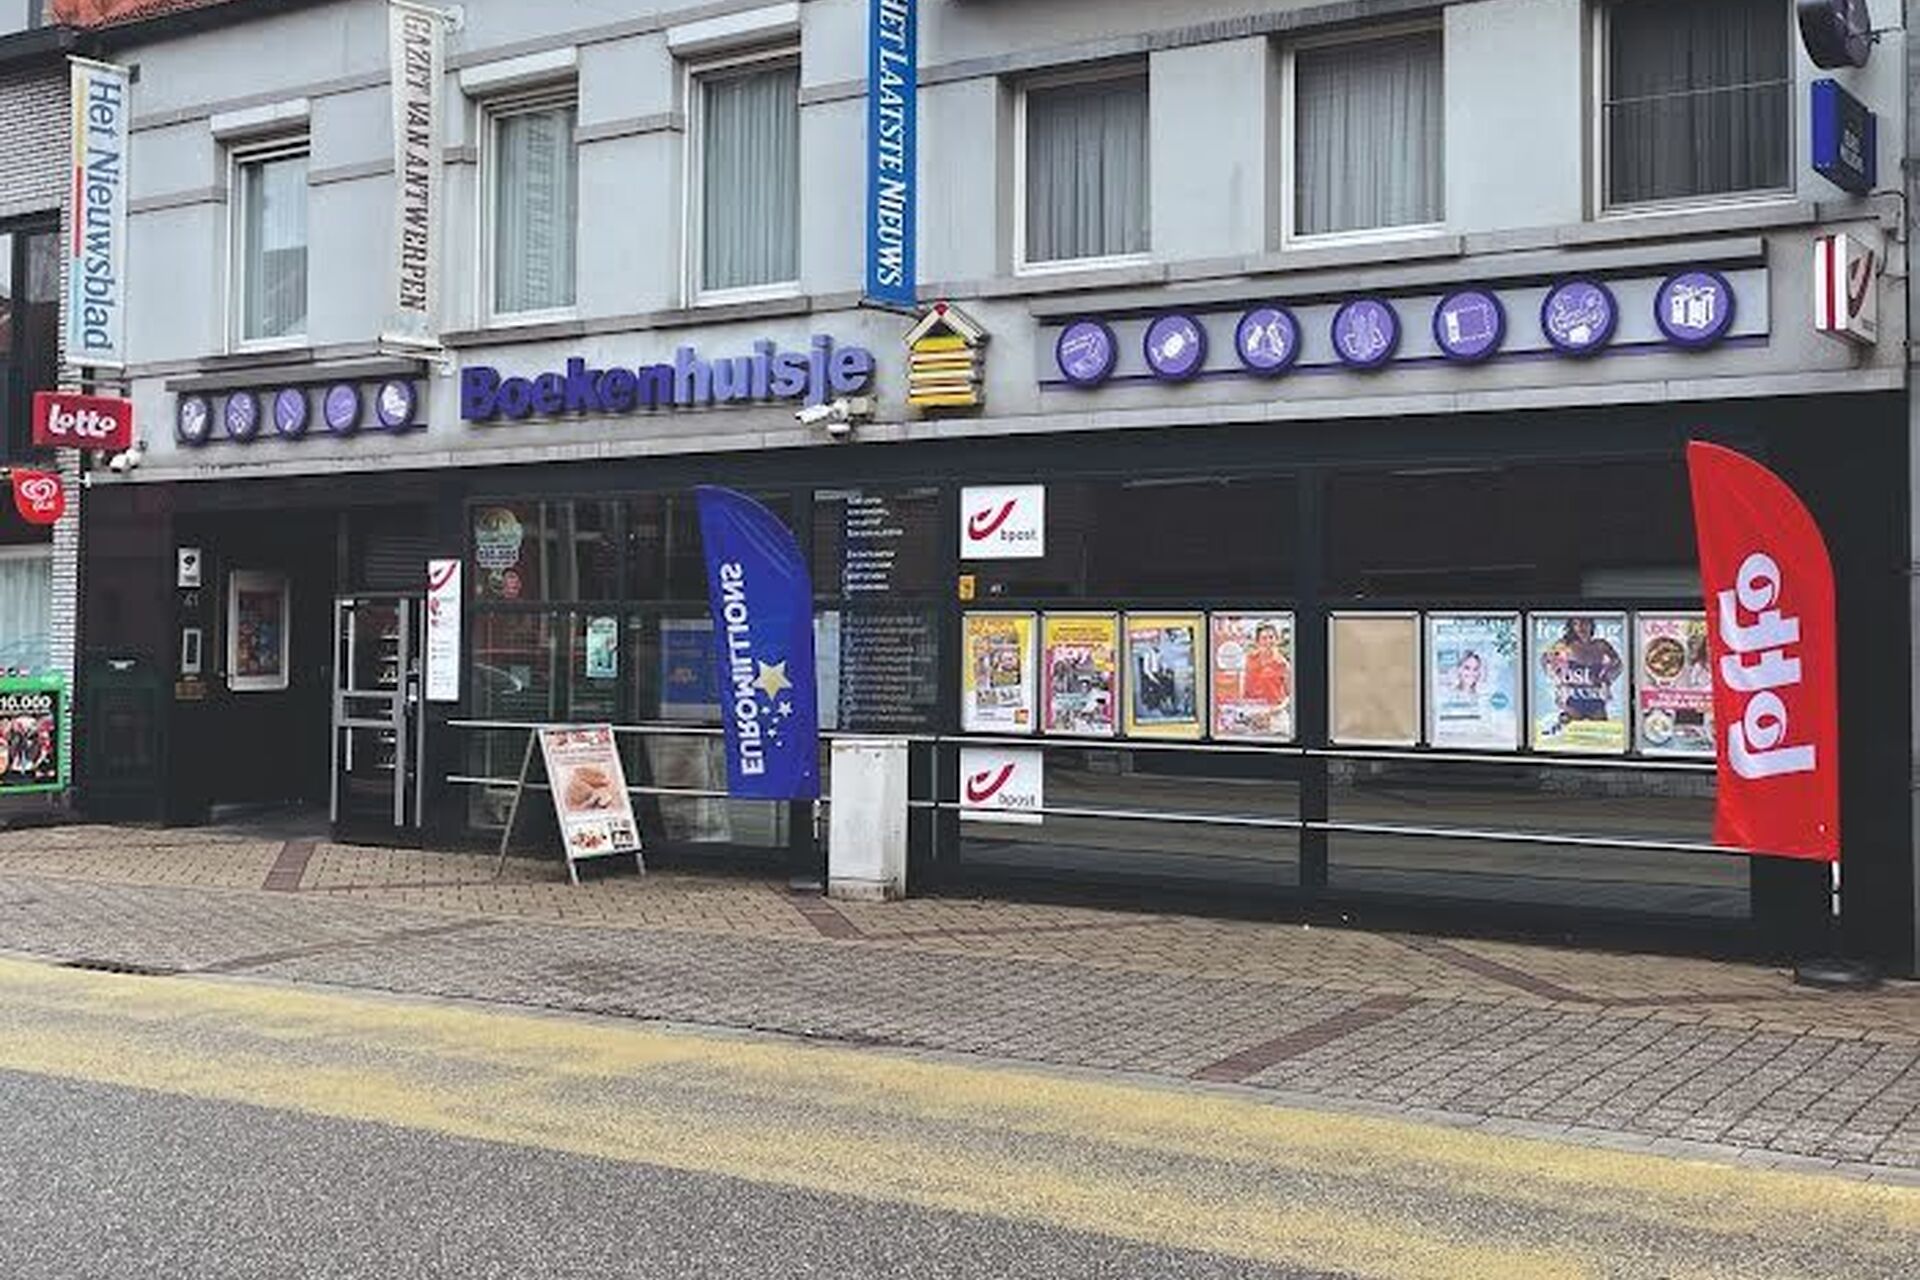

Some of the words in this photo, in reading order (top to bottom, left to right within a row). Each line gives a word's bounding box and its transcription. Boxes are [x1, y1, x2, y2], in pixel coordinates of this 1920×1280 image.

[403, 14, 431, 95] GAZET
[880, 0, 909, 46] HET
[89, 78, 122, 138] Het
[406, 100, 431, 148] VAN
[879, 46, 909, 173] LAATSTE
[84, 145, 120, 351] Nieuwsblad
[400, 151, 430, 312] ANTWERPEN
[877, 177, 907, 288] NIEUWS
[461, 334, 875, 421] Boekenhuisje
[1000, 529, 1037, 543] bpost
